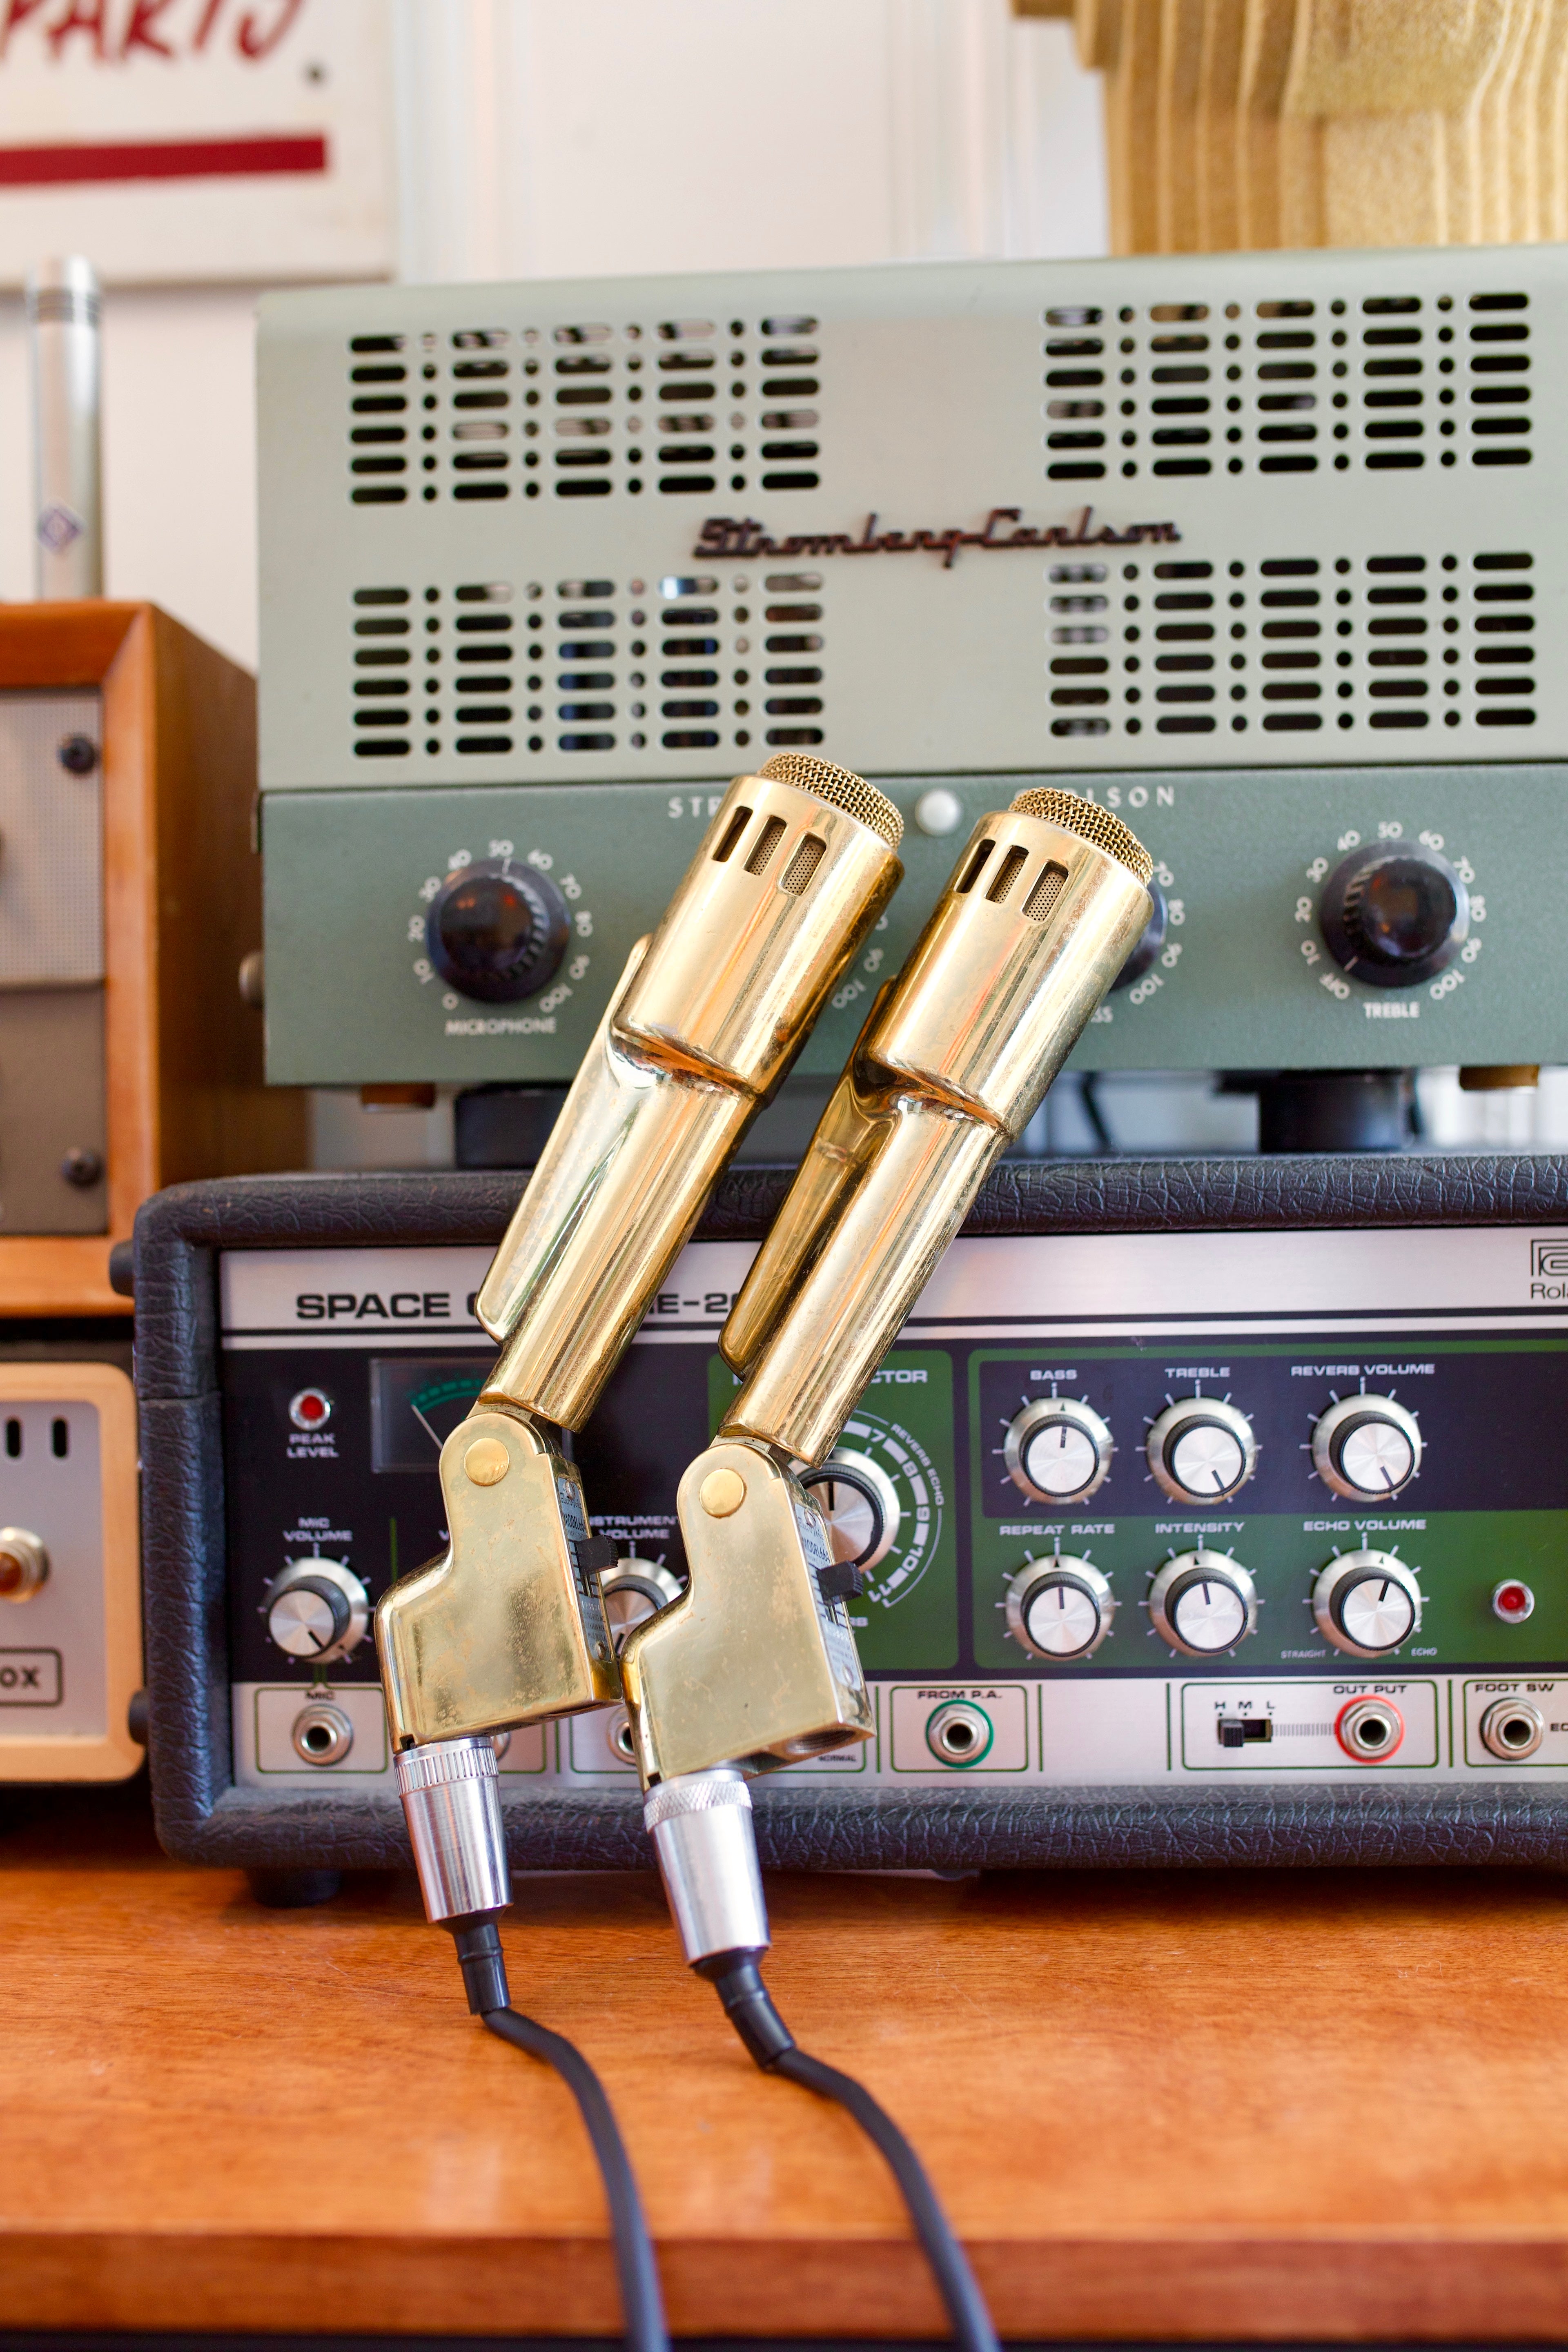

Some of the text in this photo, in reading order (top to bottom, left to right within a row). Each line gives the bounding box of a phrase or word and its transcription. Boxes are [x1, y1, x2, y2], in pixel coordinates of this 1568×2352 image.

[693, 506, 1183, 570] Stromberg-Carlson
[1378, 821, 1403, 839] 50
[489, 839, 514, 858] 50
[1337, 830, 1361, 851] 40
[1419, 830, 1444, 851] 60
[448, 849, 472, 871] 40
[528, 849, 553, 870] 60
[1306, 857, 1328, 883] 30
[1453, 855, 1475, 884] 70
[419, 876, 441, 902] 30
[559, 873, 582, 900] 70
[1295, 896, 1312, 923] 20
[1469, 895, 1487, 922] 80
[408, 915, 425, 942] 20
[575, 911, 592, 937] 80
[1301, 940, 1321, 966] 10
[1461, 938, 1482, 963] 90
[413, 958, 434, 984] 10
[569, 954, 590, 980] 90
[1430, 968, 1466, 1000] 100
[442, 992, 459, 1010] 0
[539, 983, 572, 1013] 100
[1363, 1002, 1420, 1018] TREBLE
[445, 1017, 557, 1036] MICROPHONE
[1531, 1283, 1568, 1299] Rol
[296, 1293, 450, 1319] SPACE
[1030, 1369, 1078, 1380] BASS
[1165, 1367, 1231, 1378] TREBLE
[1290, 1364, 1435, 1376] REVERB VOLUME
[289, 1433, 336, 1445] PEAK
[870, 1428, 887, 1442] 7
[287, 1446, 339, 1458] LEVEL
[891, 1423, 944, 1506] REVERB ECHO
[902, 1460, 918, 1477] 8
[298, 1517, 330, 1529] MIC
[589, 1515, 679, 1526] STRUMEN
[999, 1524, 1115, 1535] REPEAT RATE
[1155, 1522, 1245, 1533] INTENSITY
[1303, 1519, 1426, 1531] ECHO VOLUME
[283, 1530, 353, 1541] VOLUME
[598, 1529, 670, 1539] VOLUME
[902, 1546, 923, 1572] 10
[1280, 1649, 1326, 1659] STRAIGHT
[1411, 1647, 1437, 1657] ECHO
[306, 1690, 334, 1701] MIC
[917, 1690, 1002, 1699] FROM P.A.
[1333, 1685, 1408, 1694] OUT PUT
[1476, 1684, 1520, 1692] FOOT
[1215, 1701, 1276, 1710] H M L
